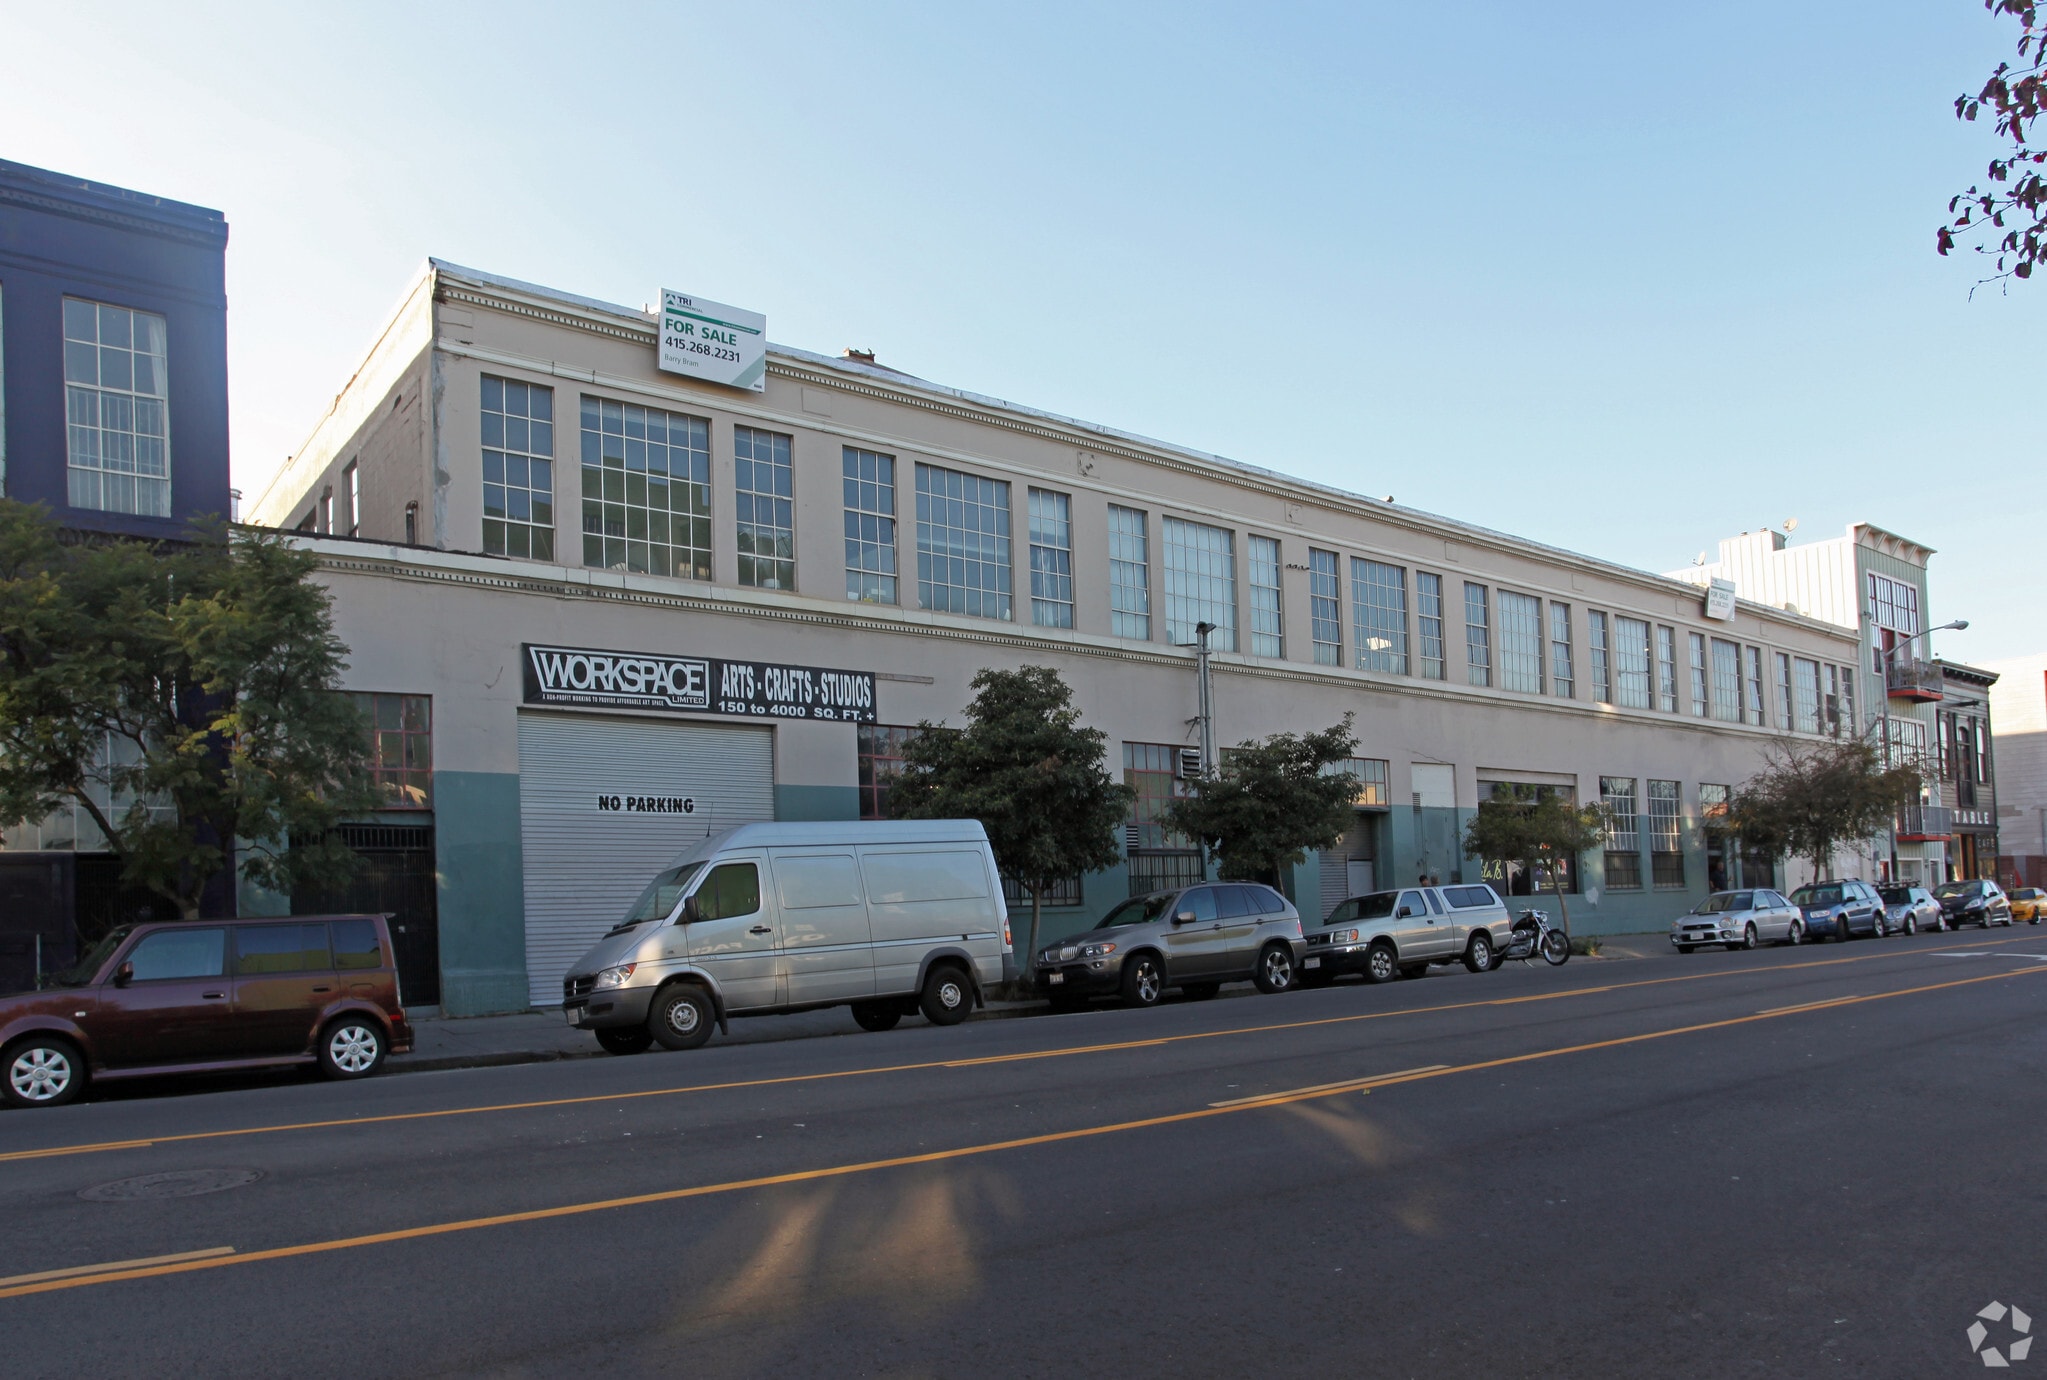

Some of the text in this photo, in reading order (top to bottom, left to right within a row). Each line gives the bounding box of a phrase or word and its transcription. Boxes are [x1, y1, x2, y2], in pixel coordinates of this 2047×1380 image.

[677, 296, 692, 306] TRI
[665, 317, 695, 336] FOR
[701, 326, 737, 346] SALE
[665, 336, 740, 363] 415.268.2231
[664, 353, 681, 365] Barry
[538, 652, 705, 697] WORKSPACE
[721, 663, 871, 708] ARTS CRAFTS STUDIOS
[572, 695, 592, 703] WORKING
[598, 696, 616, 704] PROVIDE
[616, 697, 642, 706] AFFORDABLE
[642, 698, 650, 706] ART
[651, 699, 664, 707] SPACE
[671, 695, 705, 705] LIMITED
[718, 701, 746, 713] 150
[750, 703, 766, 714] to
[769, 704, 806, 717] 4000
[814, 707, 838, 719] SQ.
[842, 709, 862, 721] FT.
[598, 795, 694, 813] NO PARKING
[1950, 810, 1988, 824] TABLE
